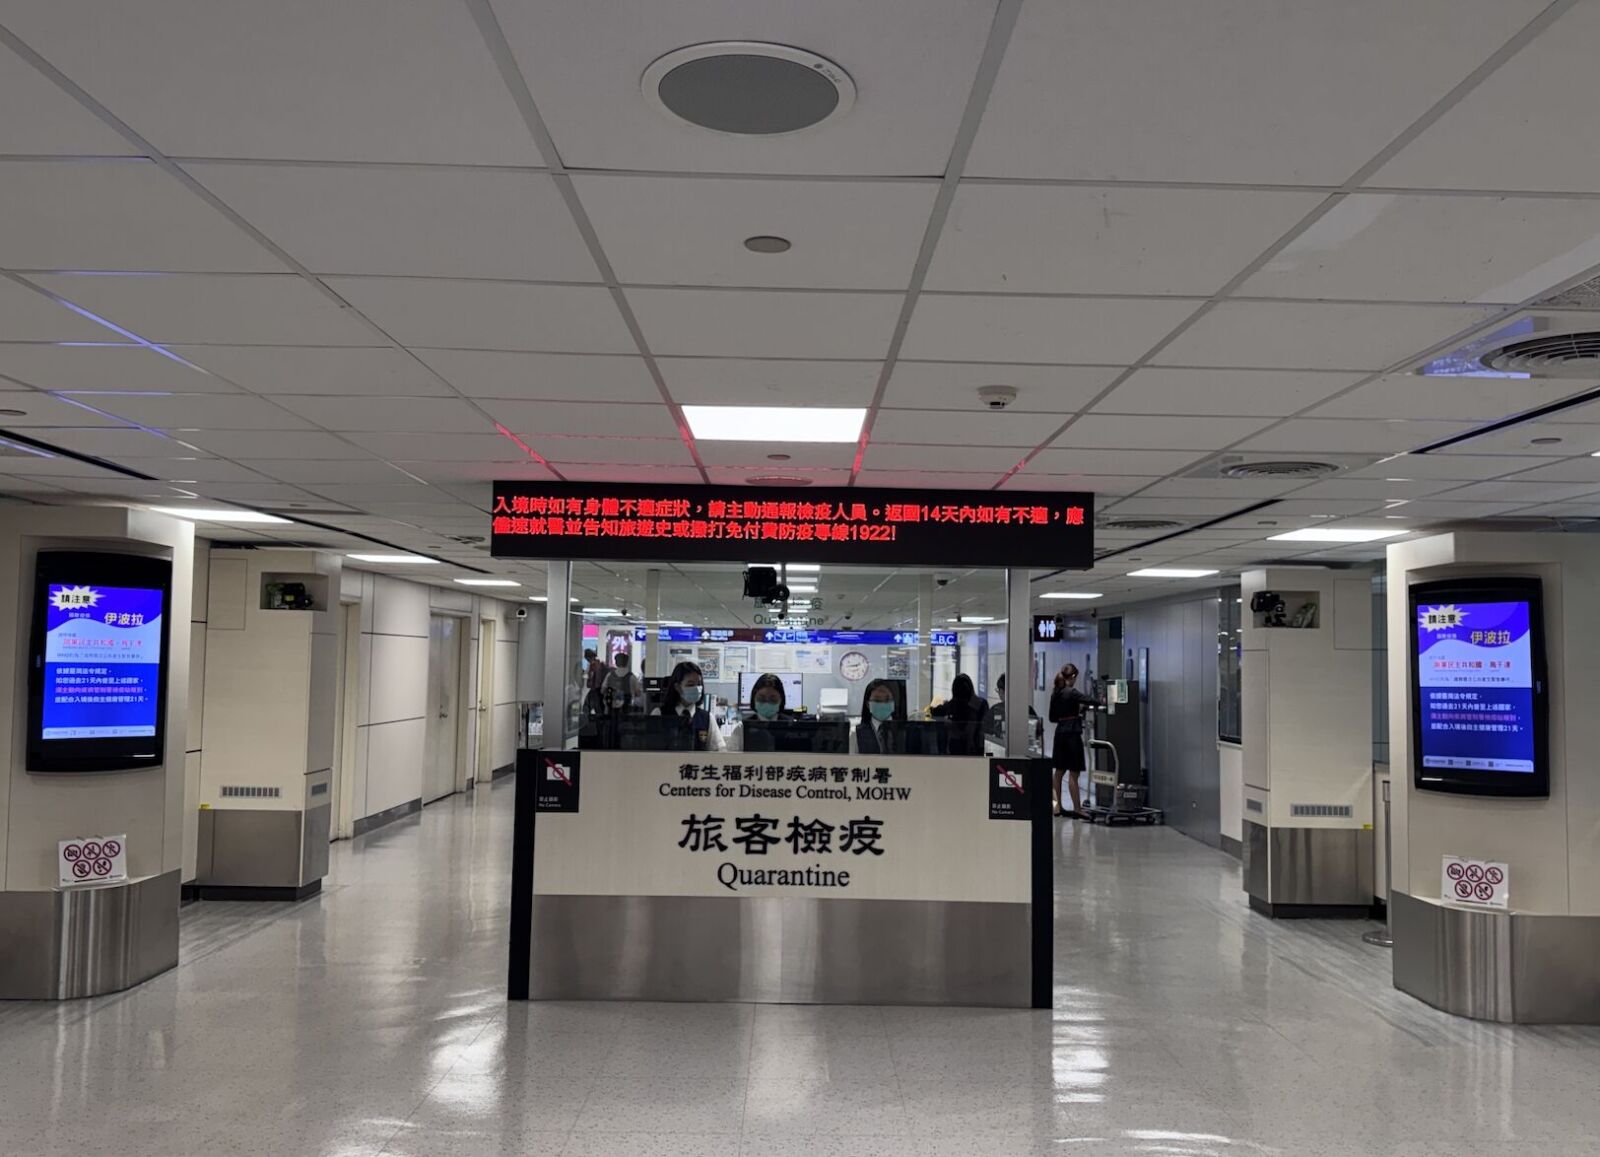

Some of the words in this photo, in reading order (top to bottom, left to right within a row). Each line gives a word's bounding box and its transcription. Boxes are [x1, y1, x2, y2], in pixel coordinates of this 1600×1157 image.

[61, 594, 91, 604] 請注意
[104, 612, 144, 626] 伊波拉
[1428, 614, 1456, 624] 請注意
[1470, 630, 1511, 645] 伊波拉
[679, 764, 892, 783] 衛生福利部疾病管制署
[659, 783, 711, 797] Centers
[716, 784, 735, 797] for
[739, 784, 791, 798] Disease
[796, 785, 851, 801] Control,
[856, 787, 911, 800] MOHW
[678, 814, 885, 855] 旅客檢疫
[717, 863, 850, 890] Quarantine
